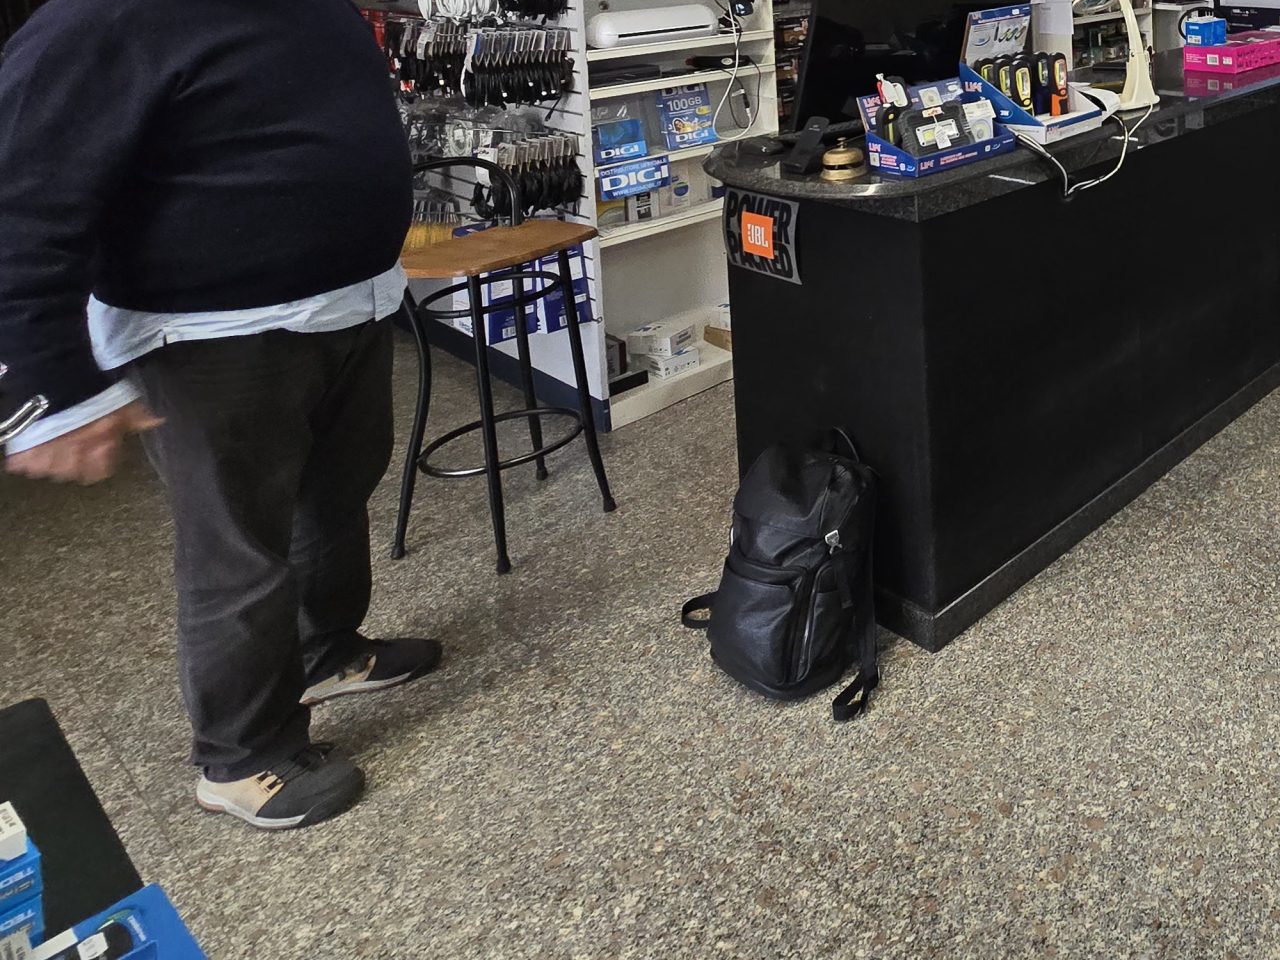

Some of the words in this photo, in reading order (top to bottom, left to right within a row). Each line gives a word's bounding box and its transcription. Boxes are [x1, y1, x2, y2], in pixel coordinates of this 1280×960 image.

[964, 81, 983, 92] LIFE
[675, 129, 709, 142] DIGI
[601, 145, 639, 159] DIGI
[920, 160, 934, 170] LIFE
[601, 164, 669, 192] DIGI
[747, 223, 769, 248] JBL
